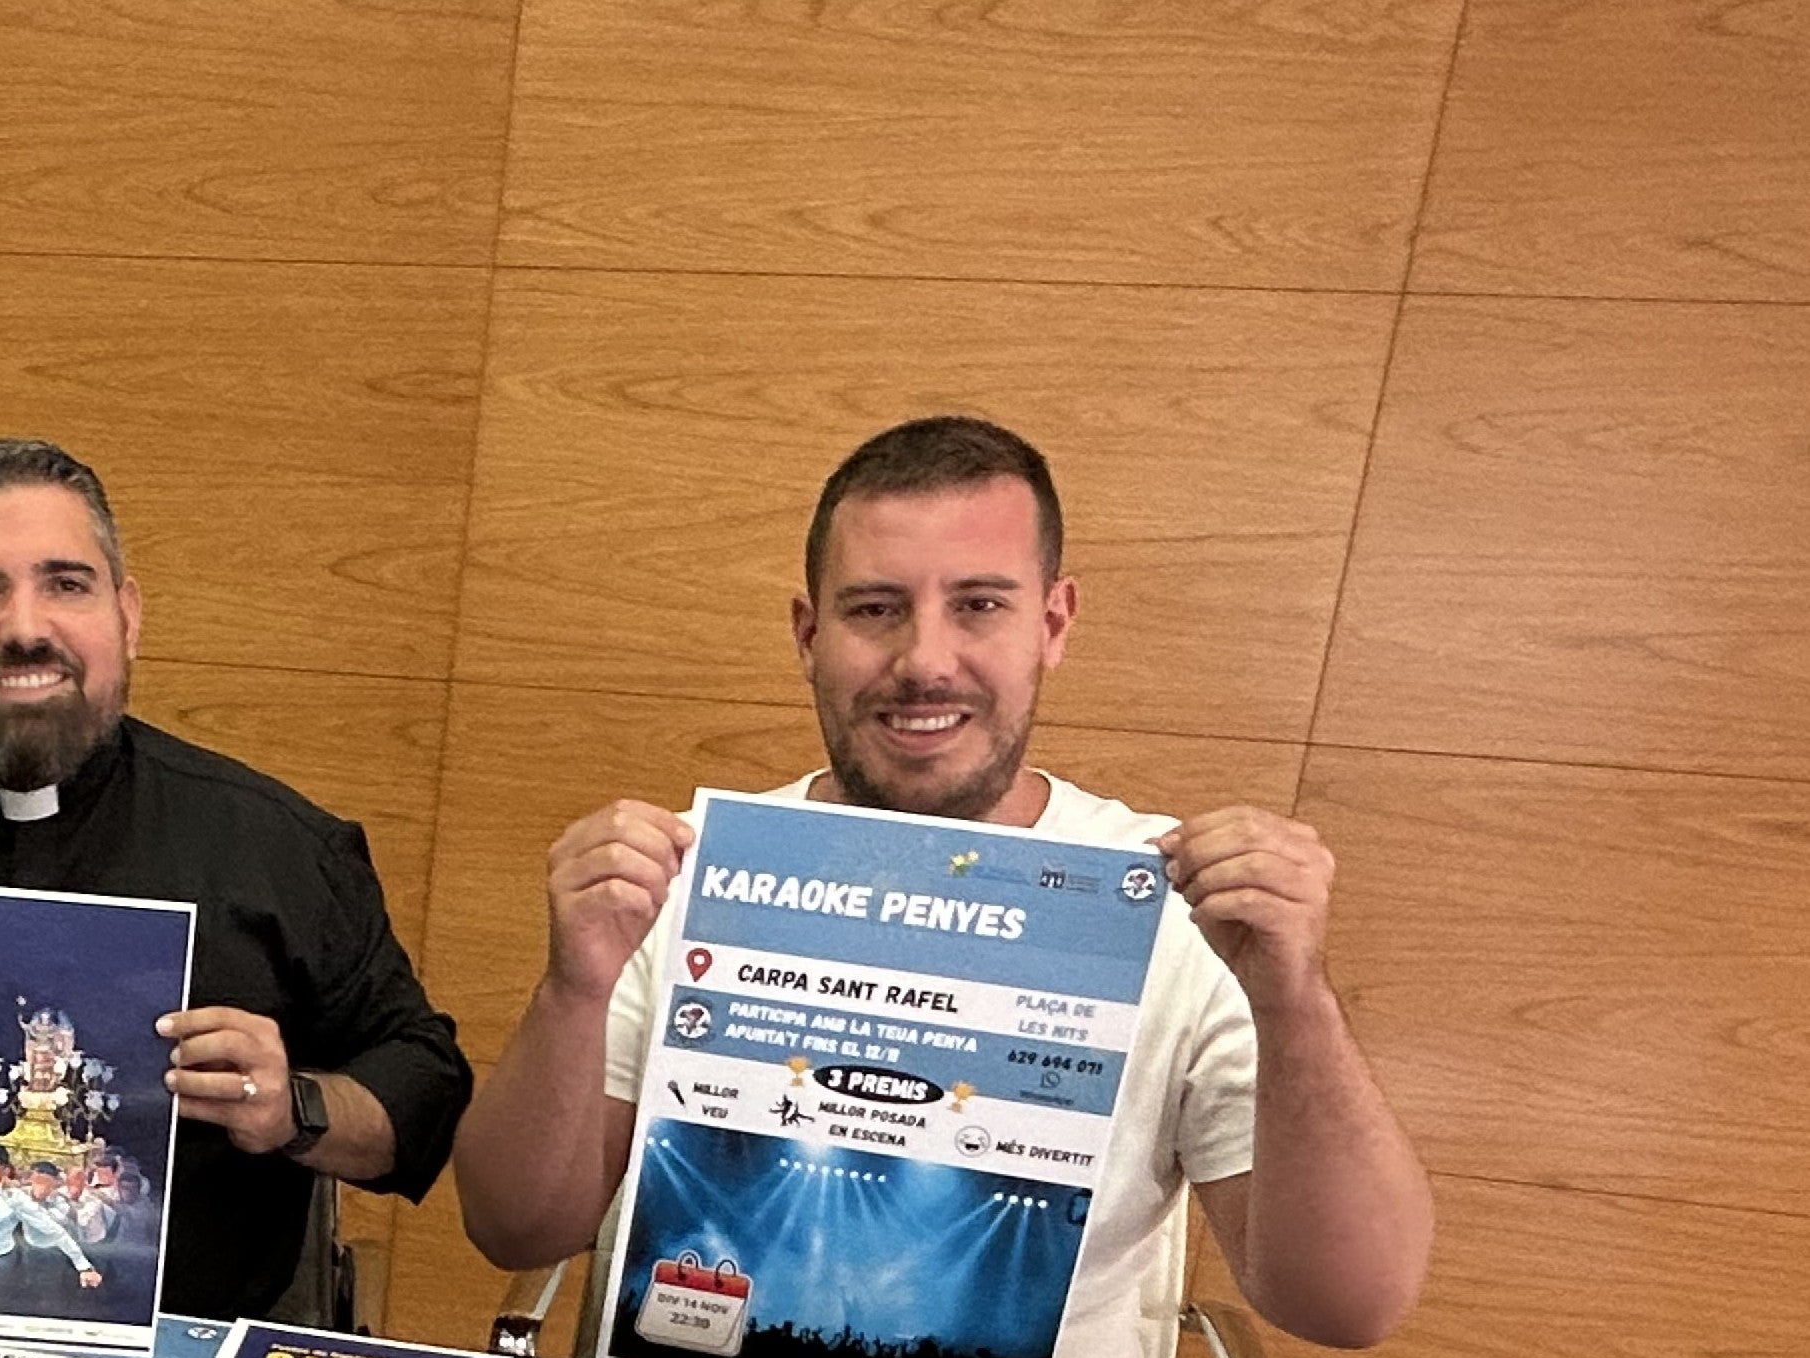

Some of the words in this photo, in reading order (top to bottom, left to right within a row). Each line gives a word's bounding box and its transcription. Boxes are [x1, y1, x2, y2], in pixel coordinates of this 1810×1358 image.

[701, 865, 872, 921] KARAOKE
[880, 892, 1027, 940] PENYES
[737, 965, 808, 994] CARPA
[817, 976, 878, 1002] SANT
[885, 985, 958, 1014] RAFEL
[828, 1069, 842, 1088] 3
[848, 1072, 928, 1100] PREMIS
[1028, 1144, 1094, 1168] DIVERTIT
